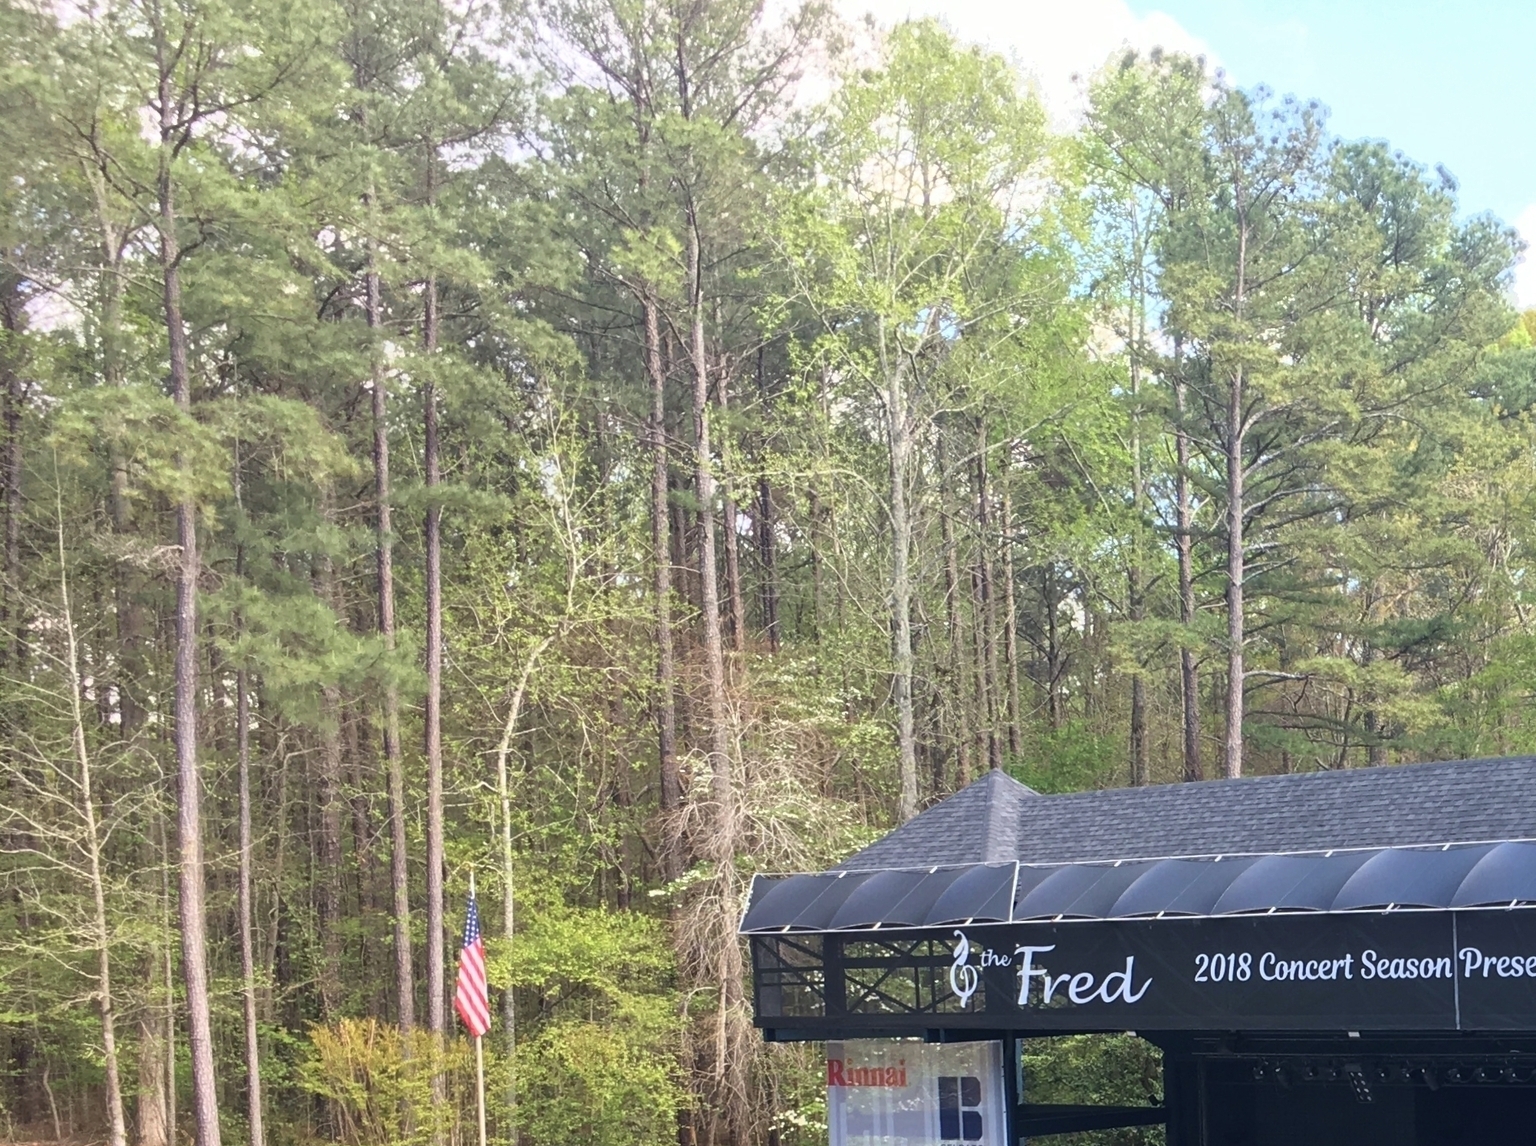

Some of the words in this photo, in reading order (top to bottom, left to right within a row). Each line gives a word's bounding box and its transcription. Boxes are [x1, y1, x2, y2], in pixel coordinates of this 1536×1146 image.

[979, 949, 1012, 967] the
[1014, 944, 1153, 1005] Fred
[1194, 952, 1252, 982] 2018
[1259, 951, 1354, 981] Concert
[1361, 949, 1452, 979] Season
[827, 1058, 907, 1087] Rinnai
